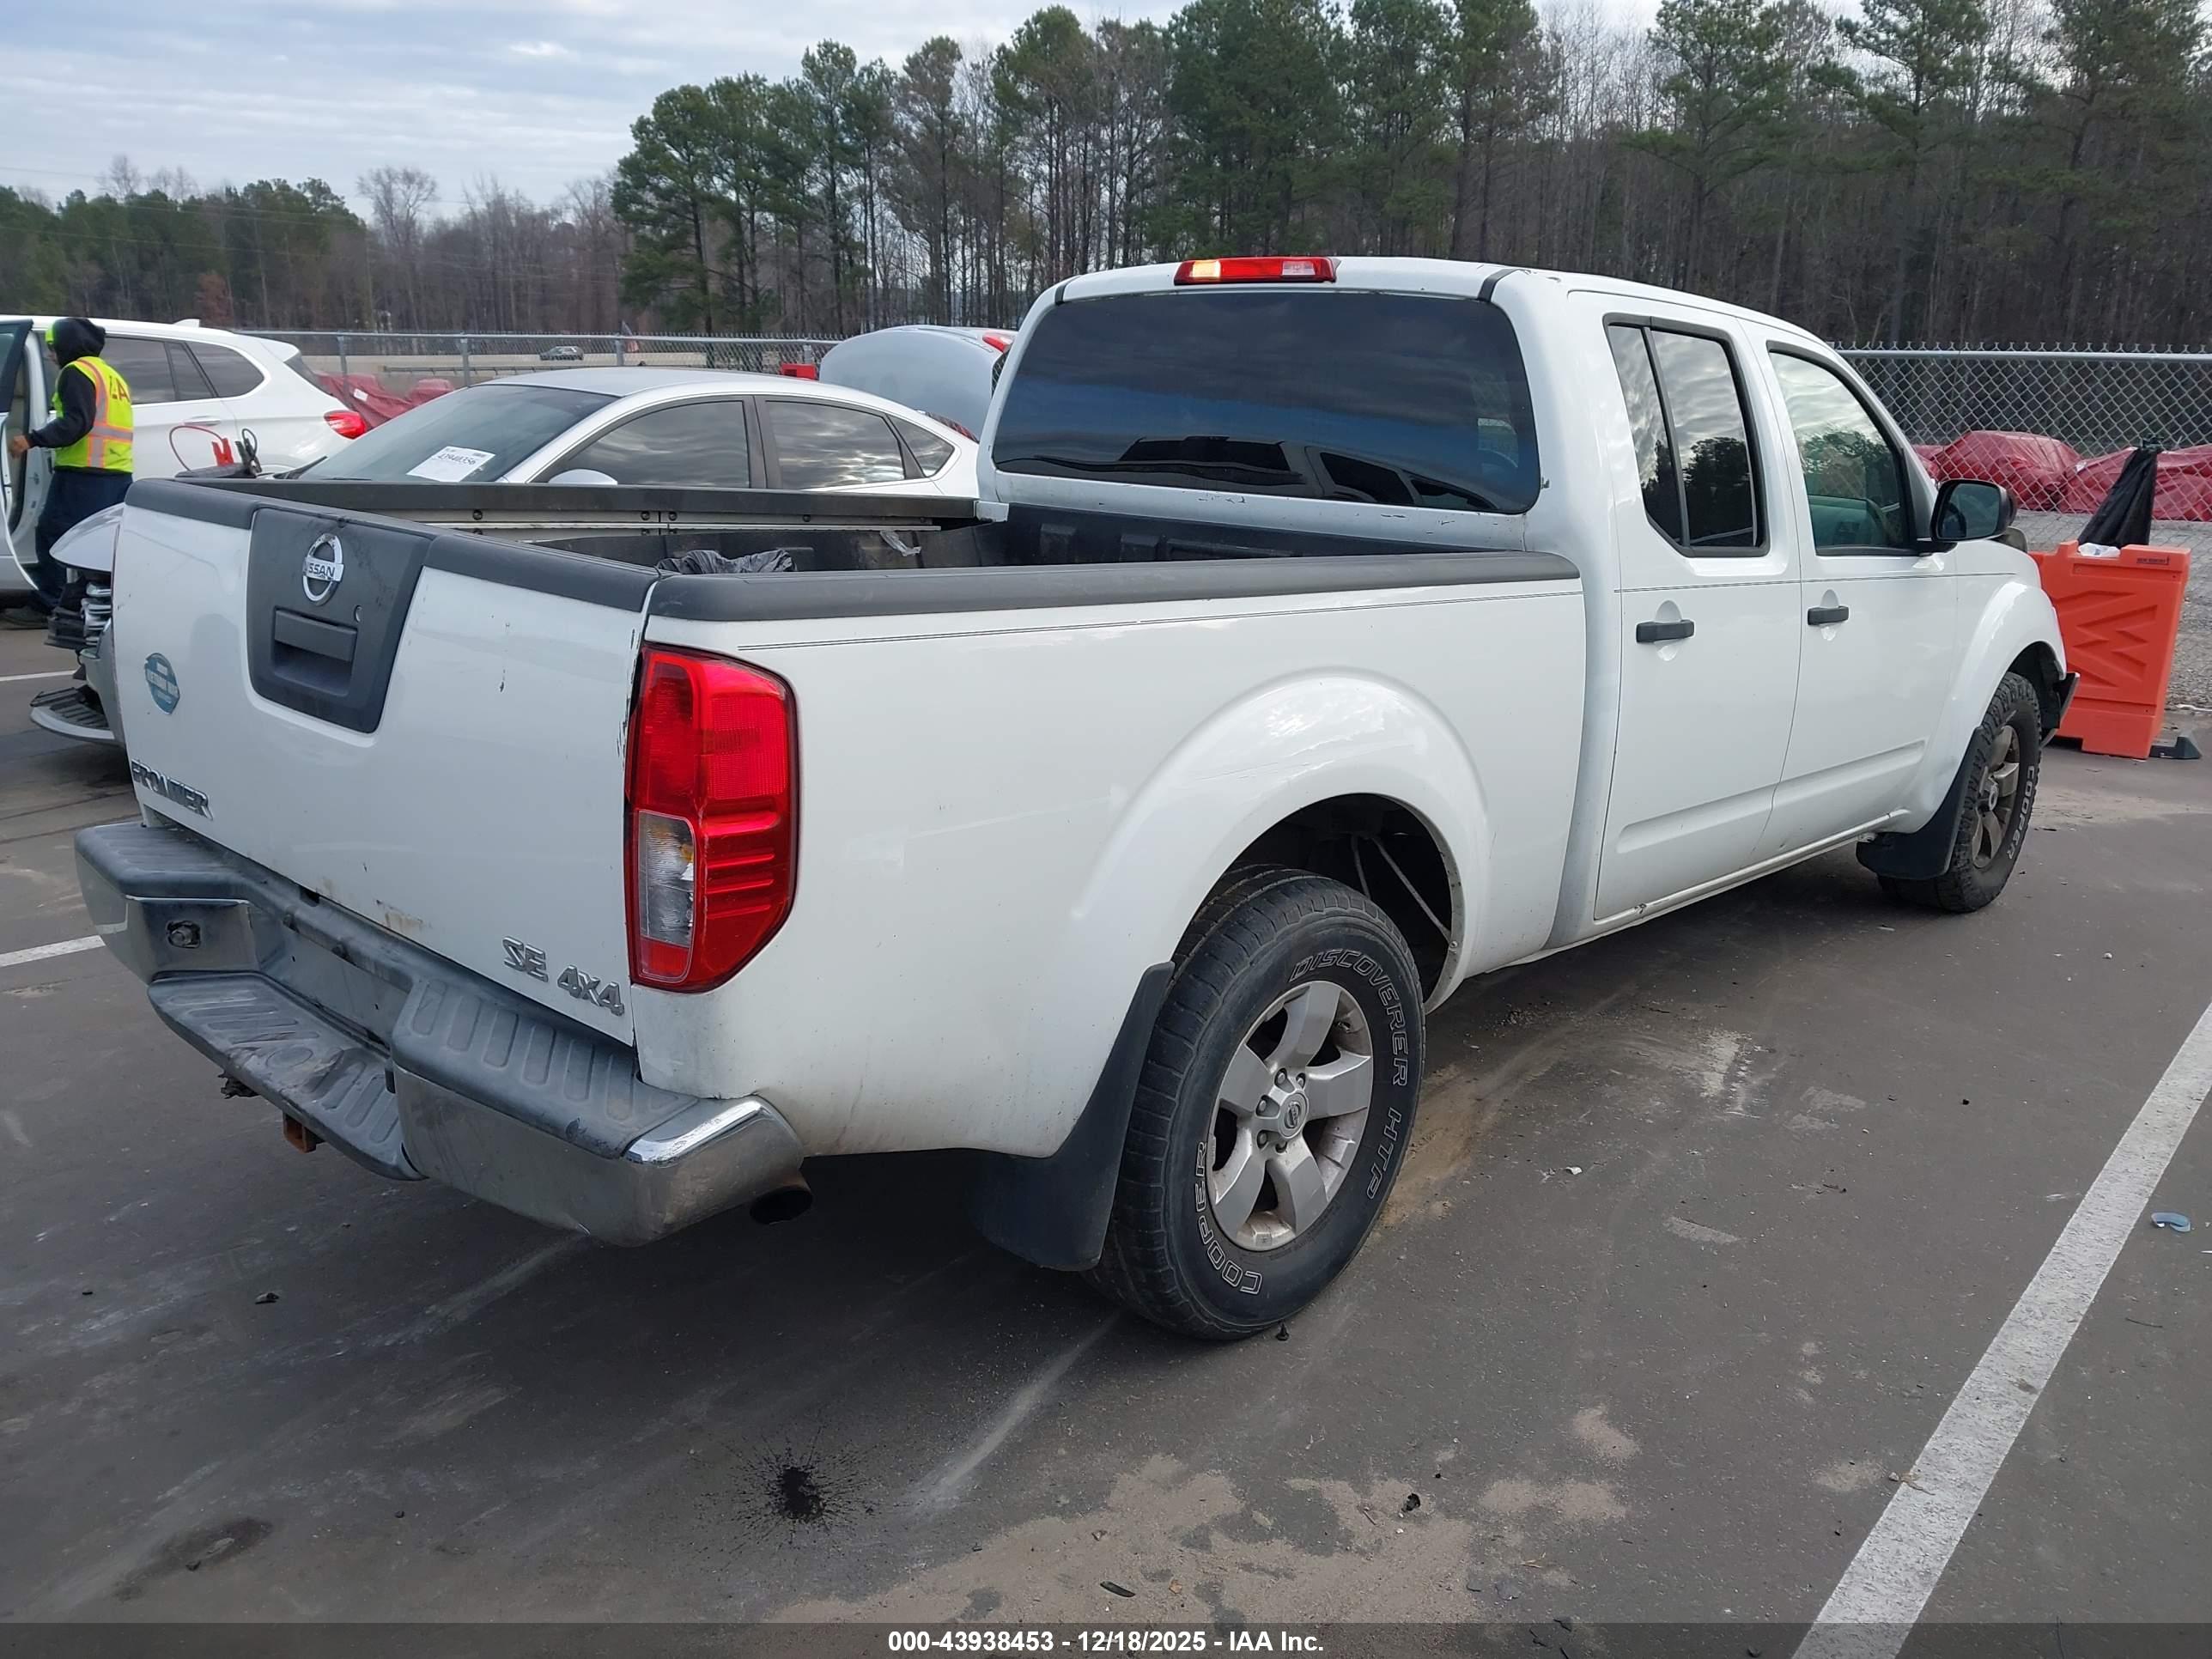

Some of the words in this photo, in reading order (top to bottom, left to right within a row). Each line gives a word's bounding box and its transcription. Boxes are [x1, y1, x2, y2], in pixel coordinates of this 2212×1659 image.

[131, 759, 213, 820] FRONTIER
[502, 936, 549, 982] SE
[1289, 948, 1409, 1087] DISCOVERER
[1367, 1106, 1402, 1200] HTP
[1194, 1141, 1263, 1295] COOPER
